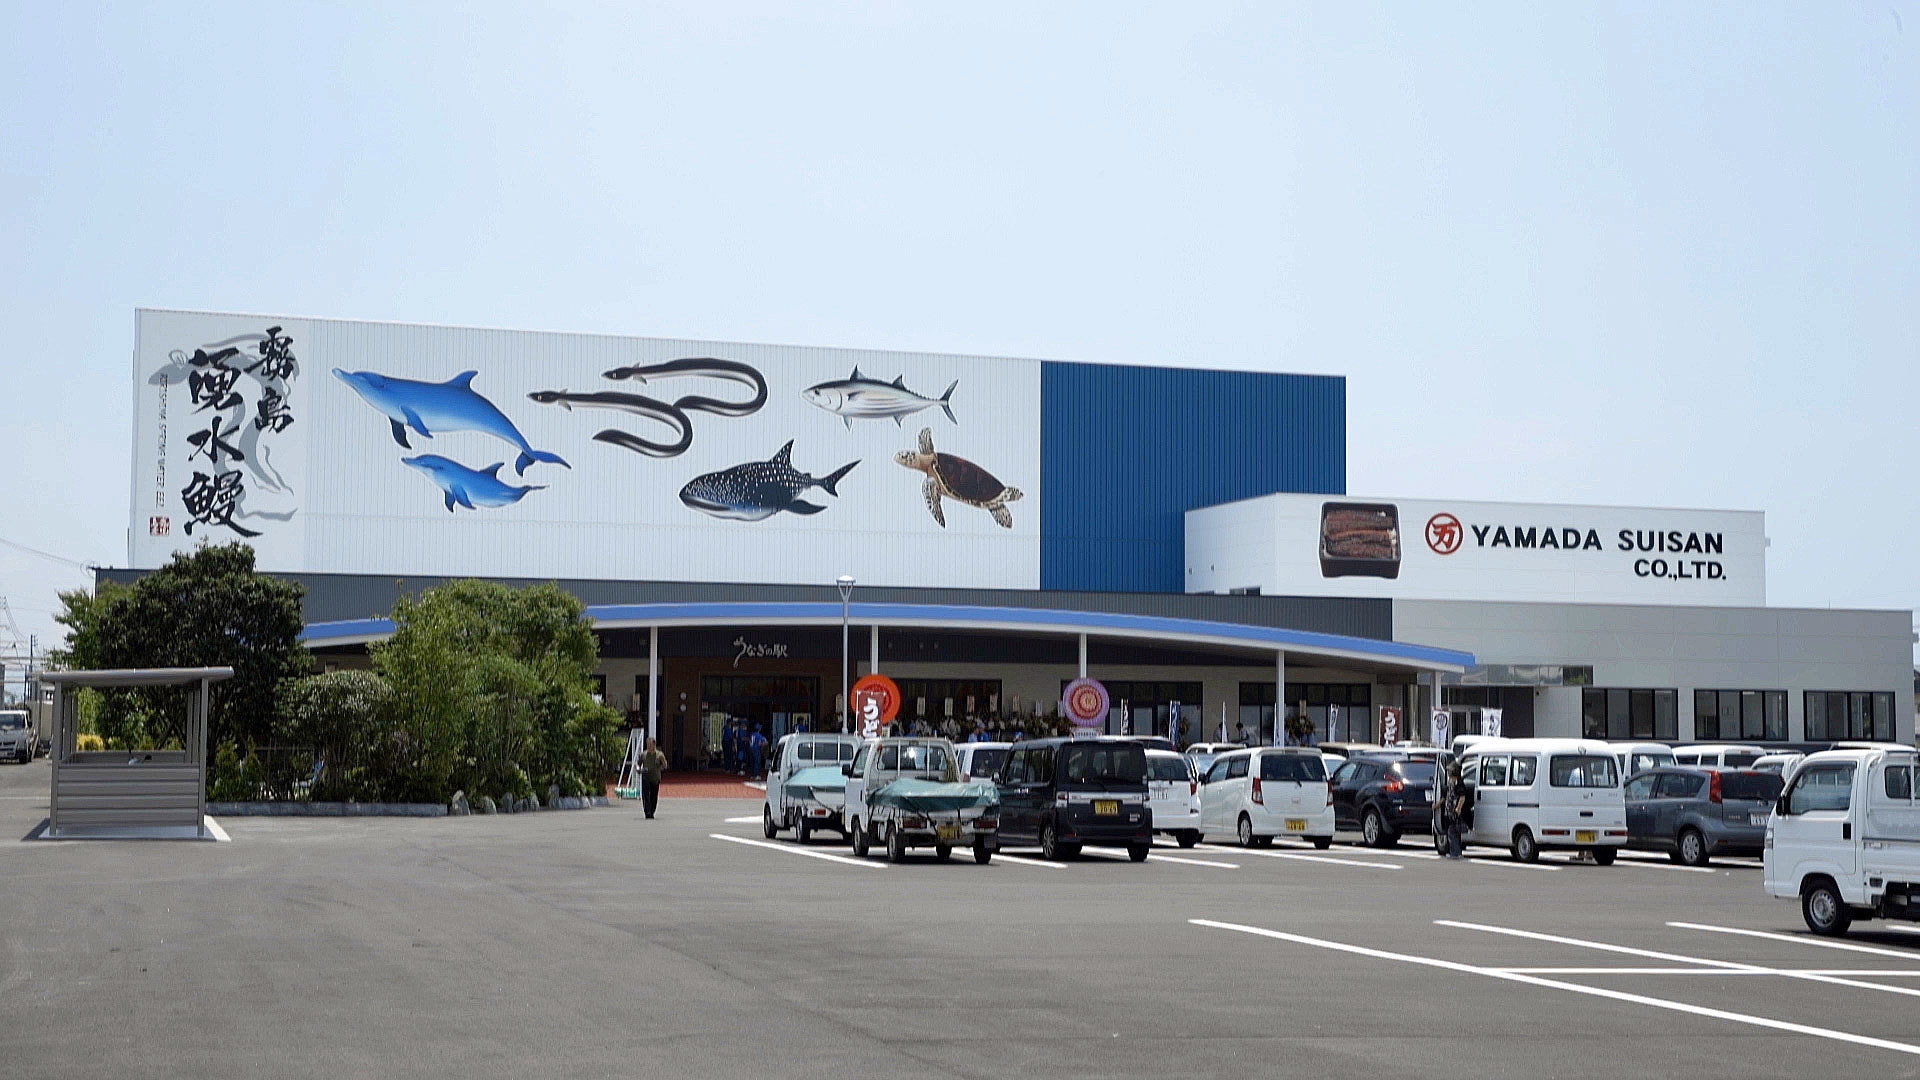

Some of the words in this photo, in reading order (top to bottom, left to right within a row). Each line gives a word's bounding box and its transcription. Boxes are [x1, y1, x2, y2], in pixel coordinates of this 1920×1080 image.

[244, 326, 294, 433] 霧島
[1471, 524, 1603, 551] YAMADA
[1617, 529, 1724, 554] SUISAN
[1633, 558, 1727, 581] CO.,LTD.
[733, 636, 788, 668] うなぎの駅
